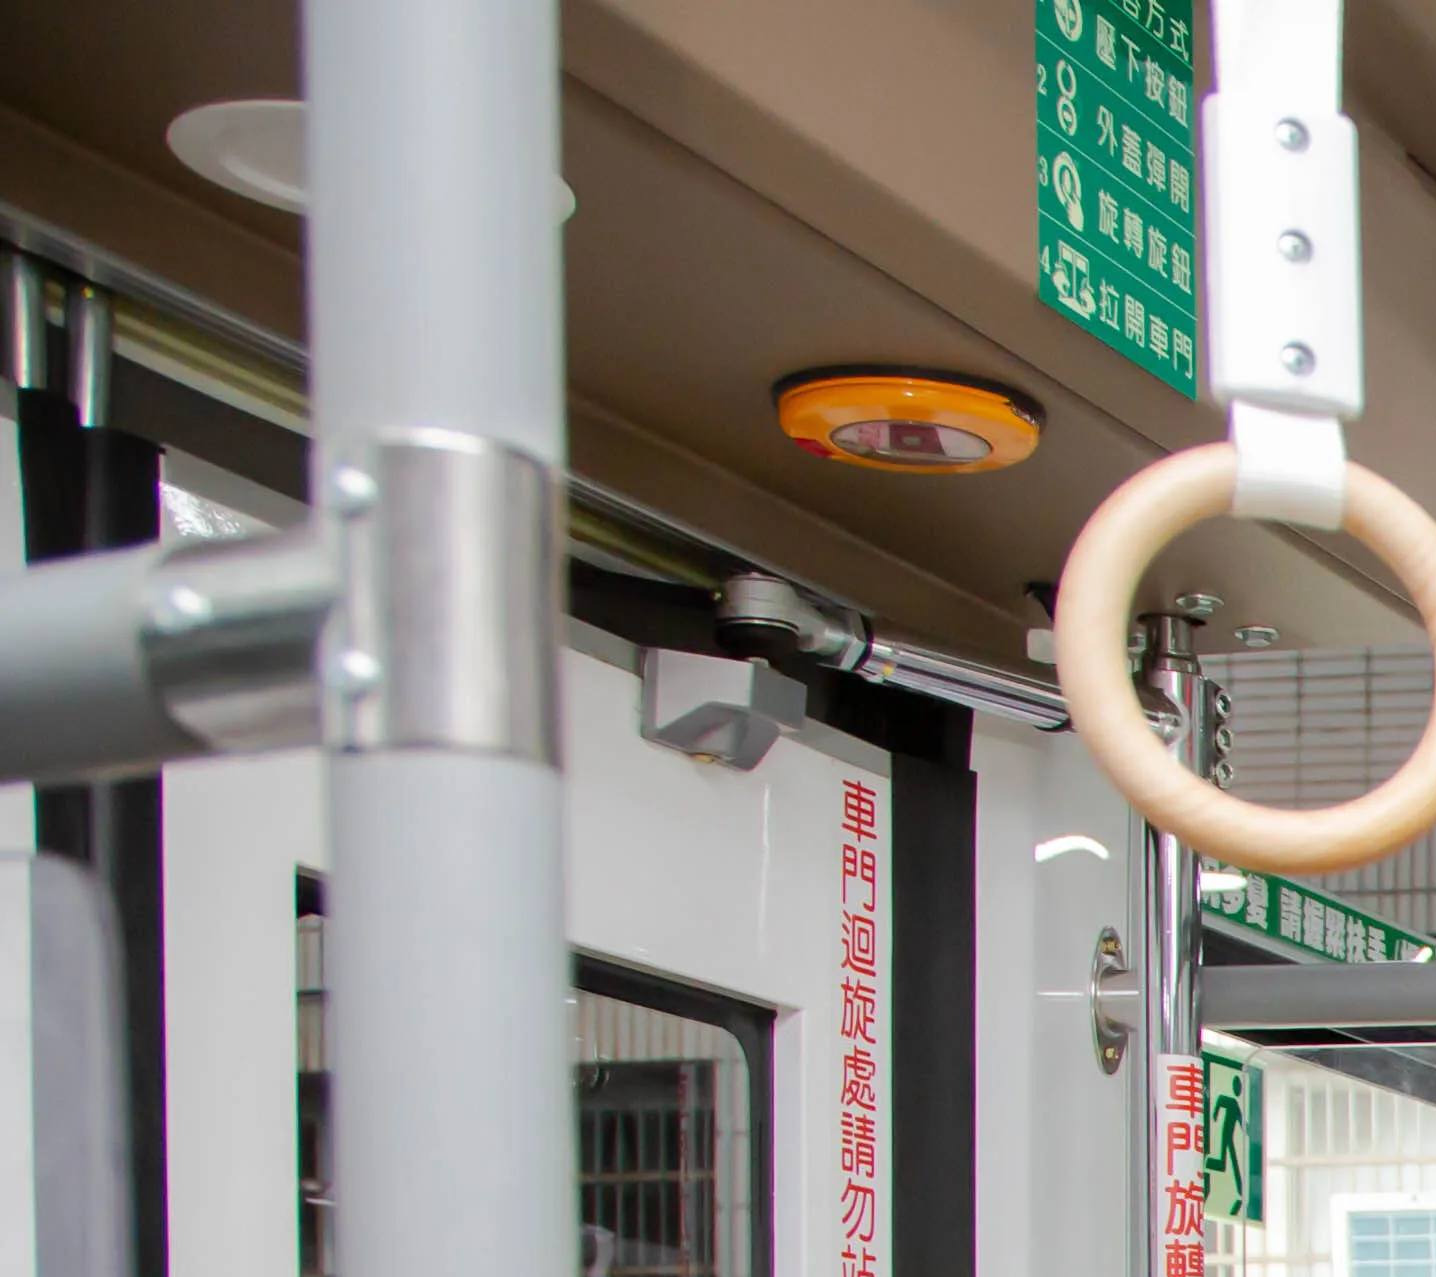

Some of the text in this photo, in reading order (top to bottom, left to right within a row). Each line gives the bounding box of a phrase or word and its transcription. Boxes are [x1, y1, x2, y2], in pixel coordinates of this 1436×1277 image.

[1095, 13, 1190, 129] 壓下按鈕
[1096, 104, 1190, 214] 外蓋彈開
[1098, 188, 1192, 296] 旋轉旋鈕
[1099, 277, 1193, 380] 拉開車門
